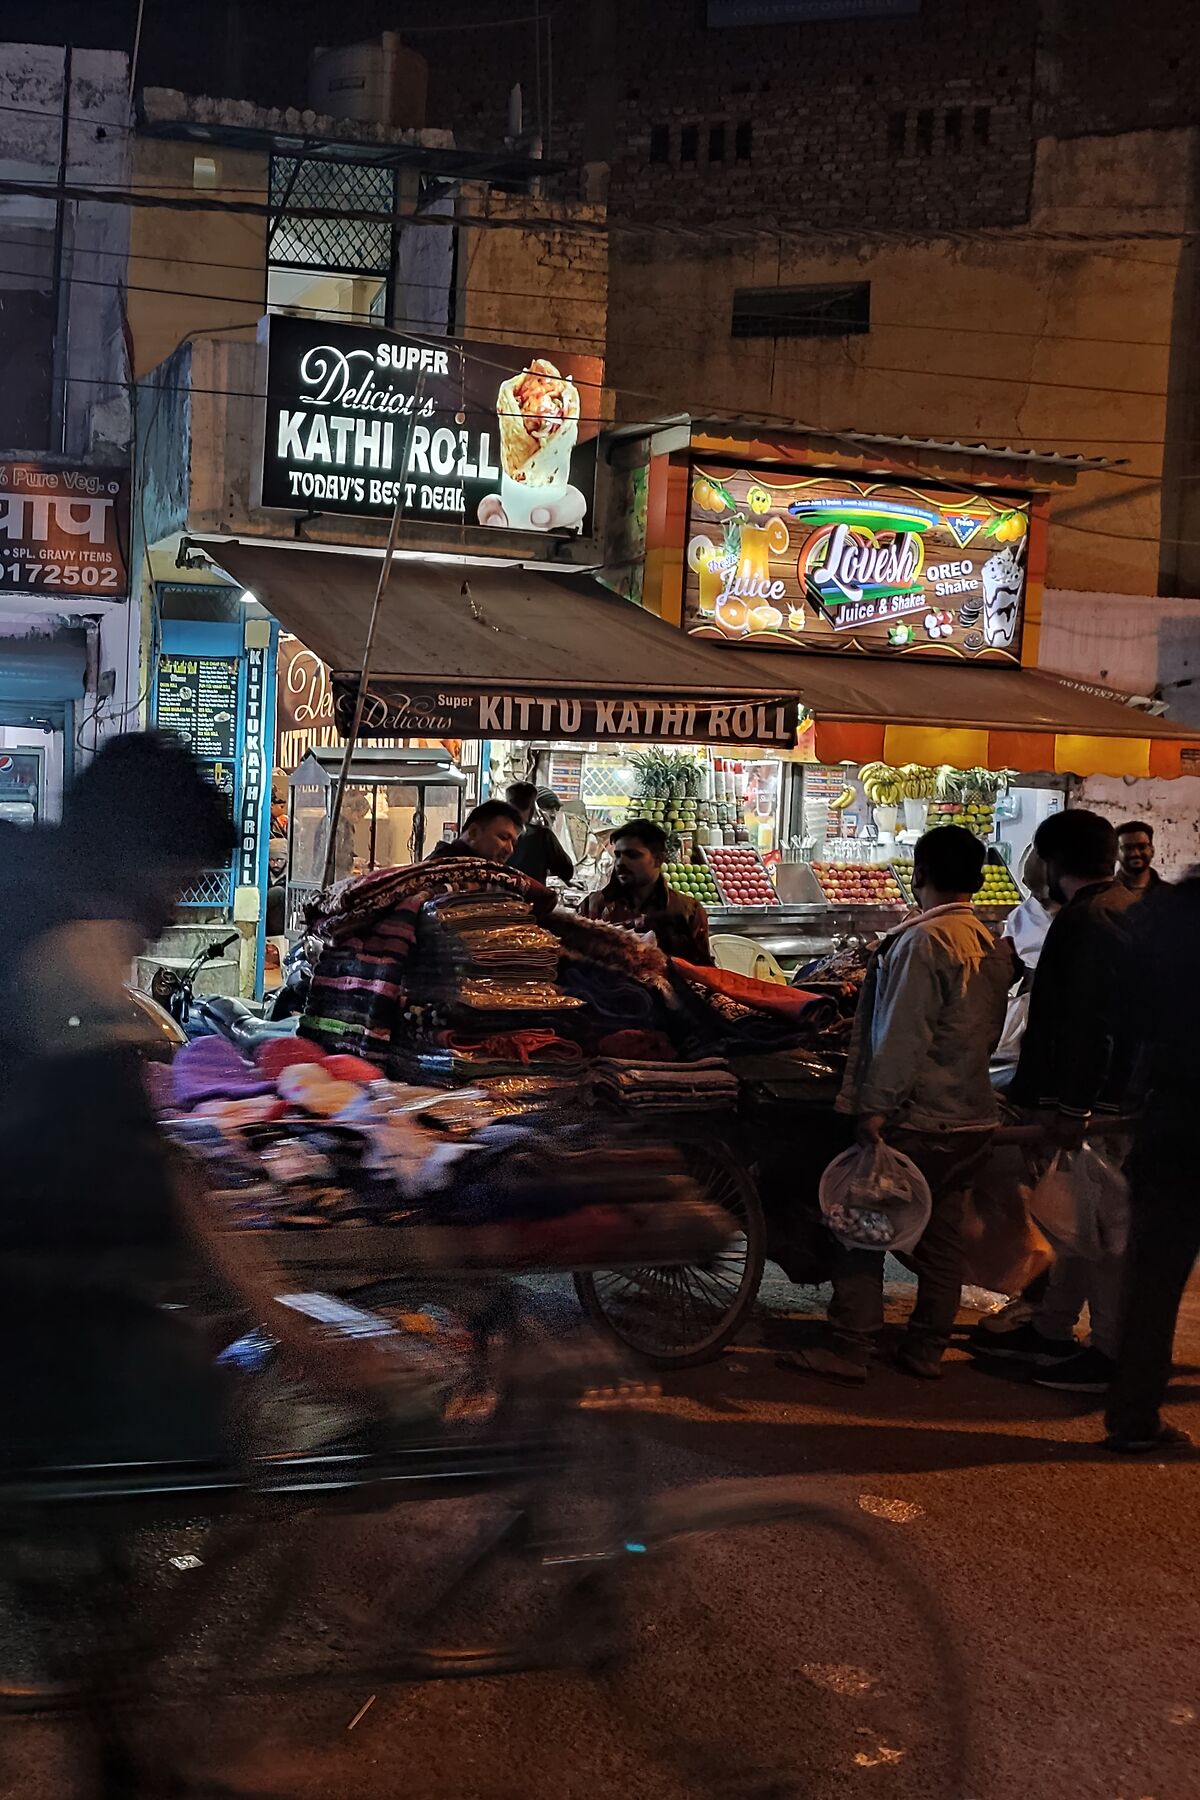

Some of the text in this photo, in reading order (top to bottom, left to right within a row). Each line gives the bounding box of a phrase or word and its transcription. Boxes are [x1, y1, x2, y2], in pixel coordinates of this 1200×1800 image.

[376, 343, 449, 375] SUPER
[277, 409, 500, 481] KATHI ROLL
[13, 468, 58, 488] Pure
[63, 472, 105, 494] Veg.
[288, 470, 365, 503] TODAY'S
[421, 484, 466, 513] DEAL
[12, 547, 36, 560] SPL.
[39, 549, 75, 561] GRAVY
[79, 551, 113, 563] ITEMS
[814, 524, 916, 601] Lovesh
[926, 560, 973, 582] OREO
[716, 566, 786, 606] Juice
[935, 578, 979, 597] Shake
[835, 592, 926, 625] Juice & Shakes
[437, 694, 474, 708] Super
[478, 695, 582, 734] KITTU
[595, 699, 695, 736] KATHI
[708, 703, 791, 739] ROLL
